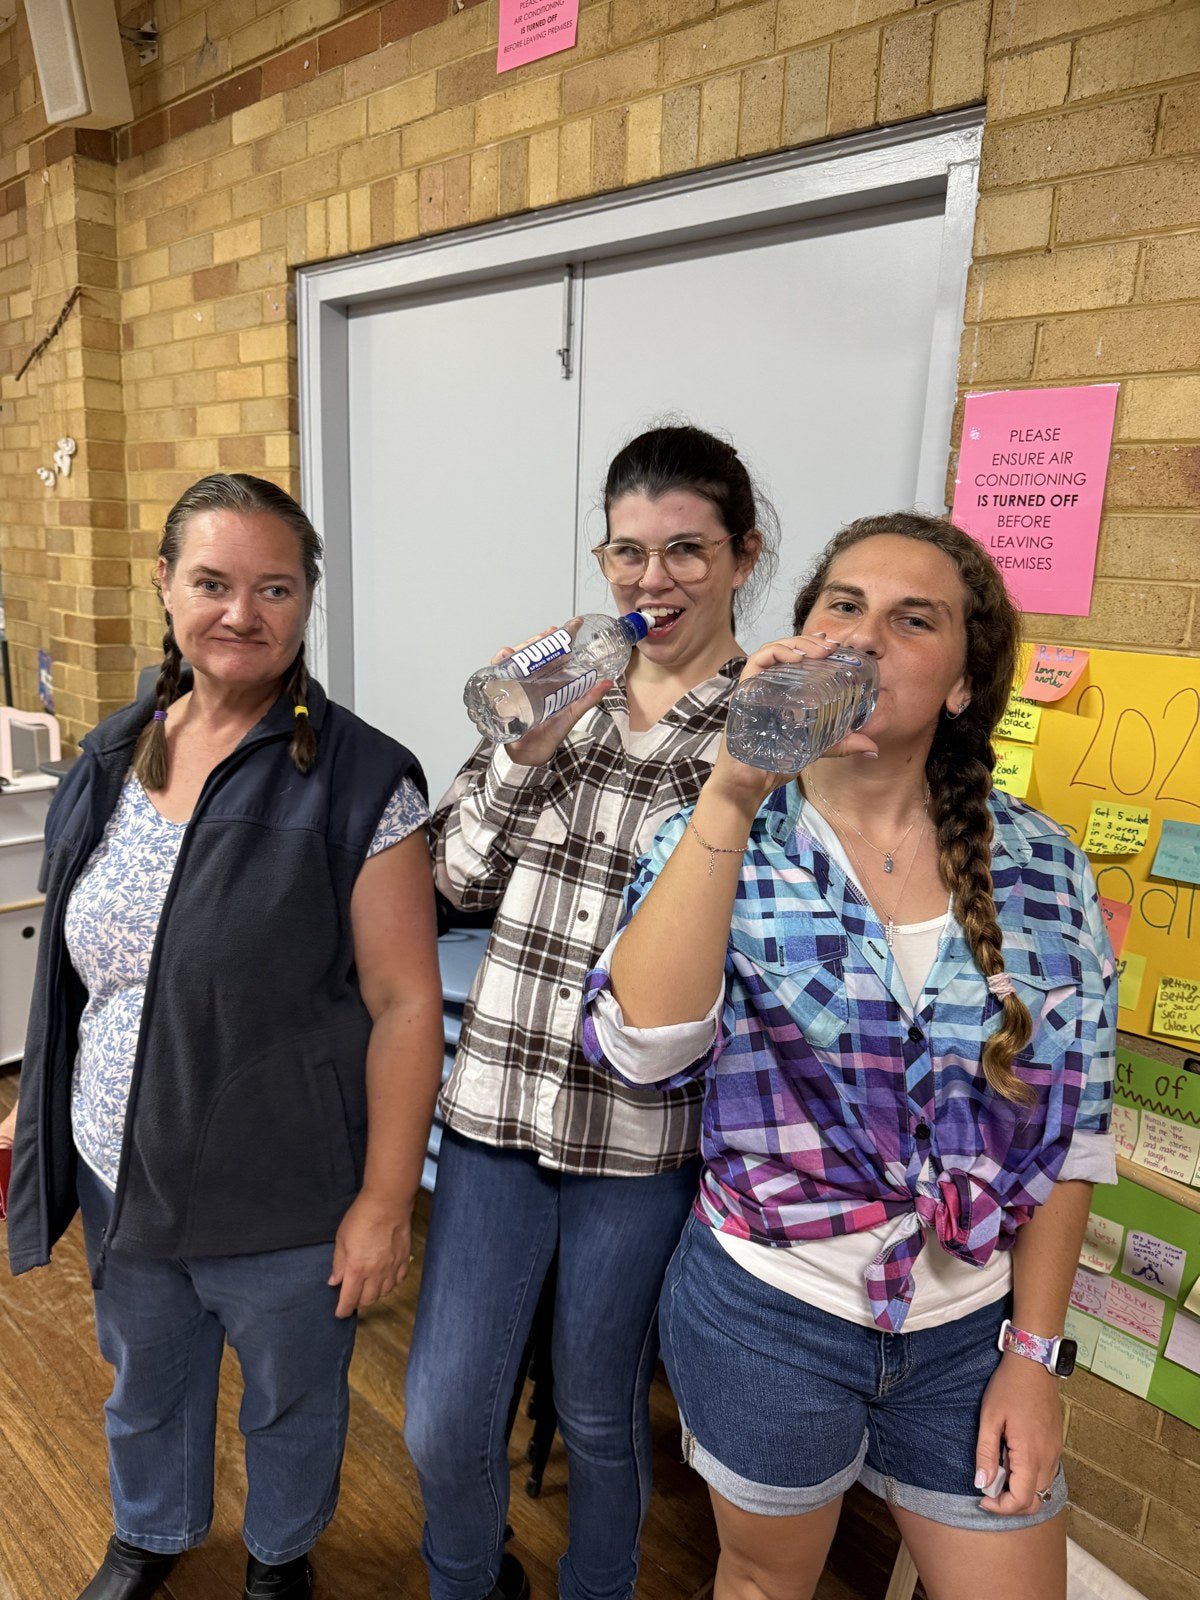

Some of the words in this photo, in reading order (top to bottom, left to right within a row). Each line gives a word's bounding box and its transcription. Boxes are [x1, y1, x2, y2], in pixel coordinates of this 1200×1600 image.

[513, 15, 522, 25] AIR
[523, 0, 565, 20] CONDITIONING
[526, 18, 546, 32] TURNED
[547, 13, 558, 23] OFF
[503, 40, 523, 54] BEFORE
[523, 31, 547, 46] LEAVING
[547, 19, 574, 35] PREMISES
[1009, 428, 1061, 442] PLEASE
[992, 453, 1044, 466] ENSURE
[1048, 451, 1074, 465] AIR
[974, 472, 1087, 487] CONDITIONING
[977, 495, 988, 507] IS
[993, 495, 1046, 507] TURNED
[1050, 494, 1079, 507] OFF
[997, 515, 1052, 528] BEFORE
[990, 536, 1054, 550] LEAVING
[529, 660, 547, 672] SPRING
[546, 651, 561, 662] WATER
[1095, 808, 1110, 818] Get
[1117, 811, 1124, 820] 5
[1093, 819, 1101, 827] in
